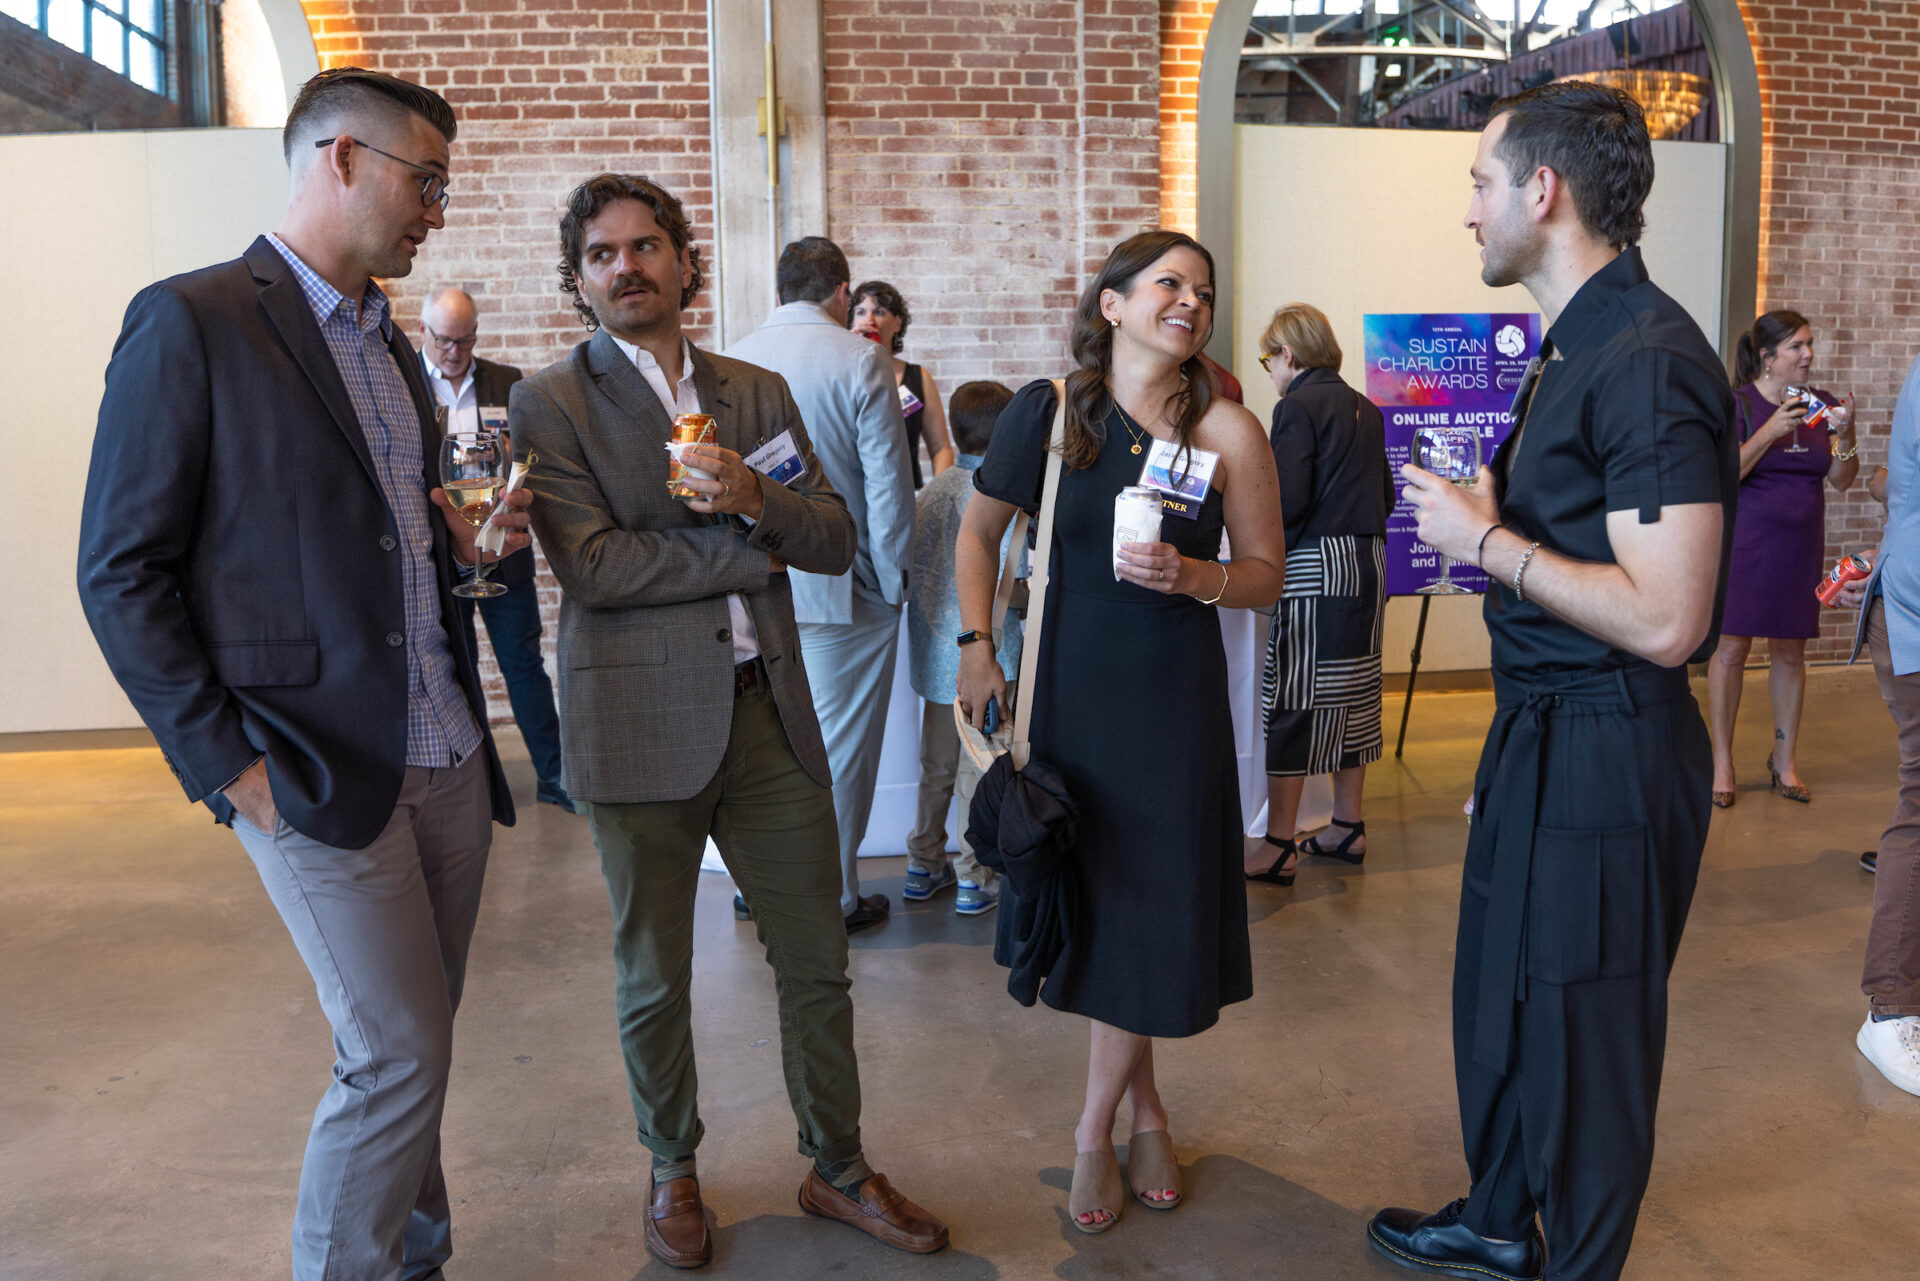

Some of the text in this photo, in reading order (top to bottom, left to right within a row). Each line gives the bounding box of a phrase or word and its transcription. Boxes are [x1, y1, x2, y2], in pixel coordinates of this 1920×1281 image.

[1409, 338, 1487, 354] SUSTAIN
[1378, 356, 1488, 372] CHARLOTTE
[1406, 375, 1488, 390] AWARDS
[1393, 413, 1449, 425] ONLINE
[765, 444, 786, 459] Gregory
[1179, 455, 1204, 468] Grgory
[1162, 499, 1187, 513] TNER
[1410, 542, 1437, 554] Join
[1411, 556, 1435, 568] and
